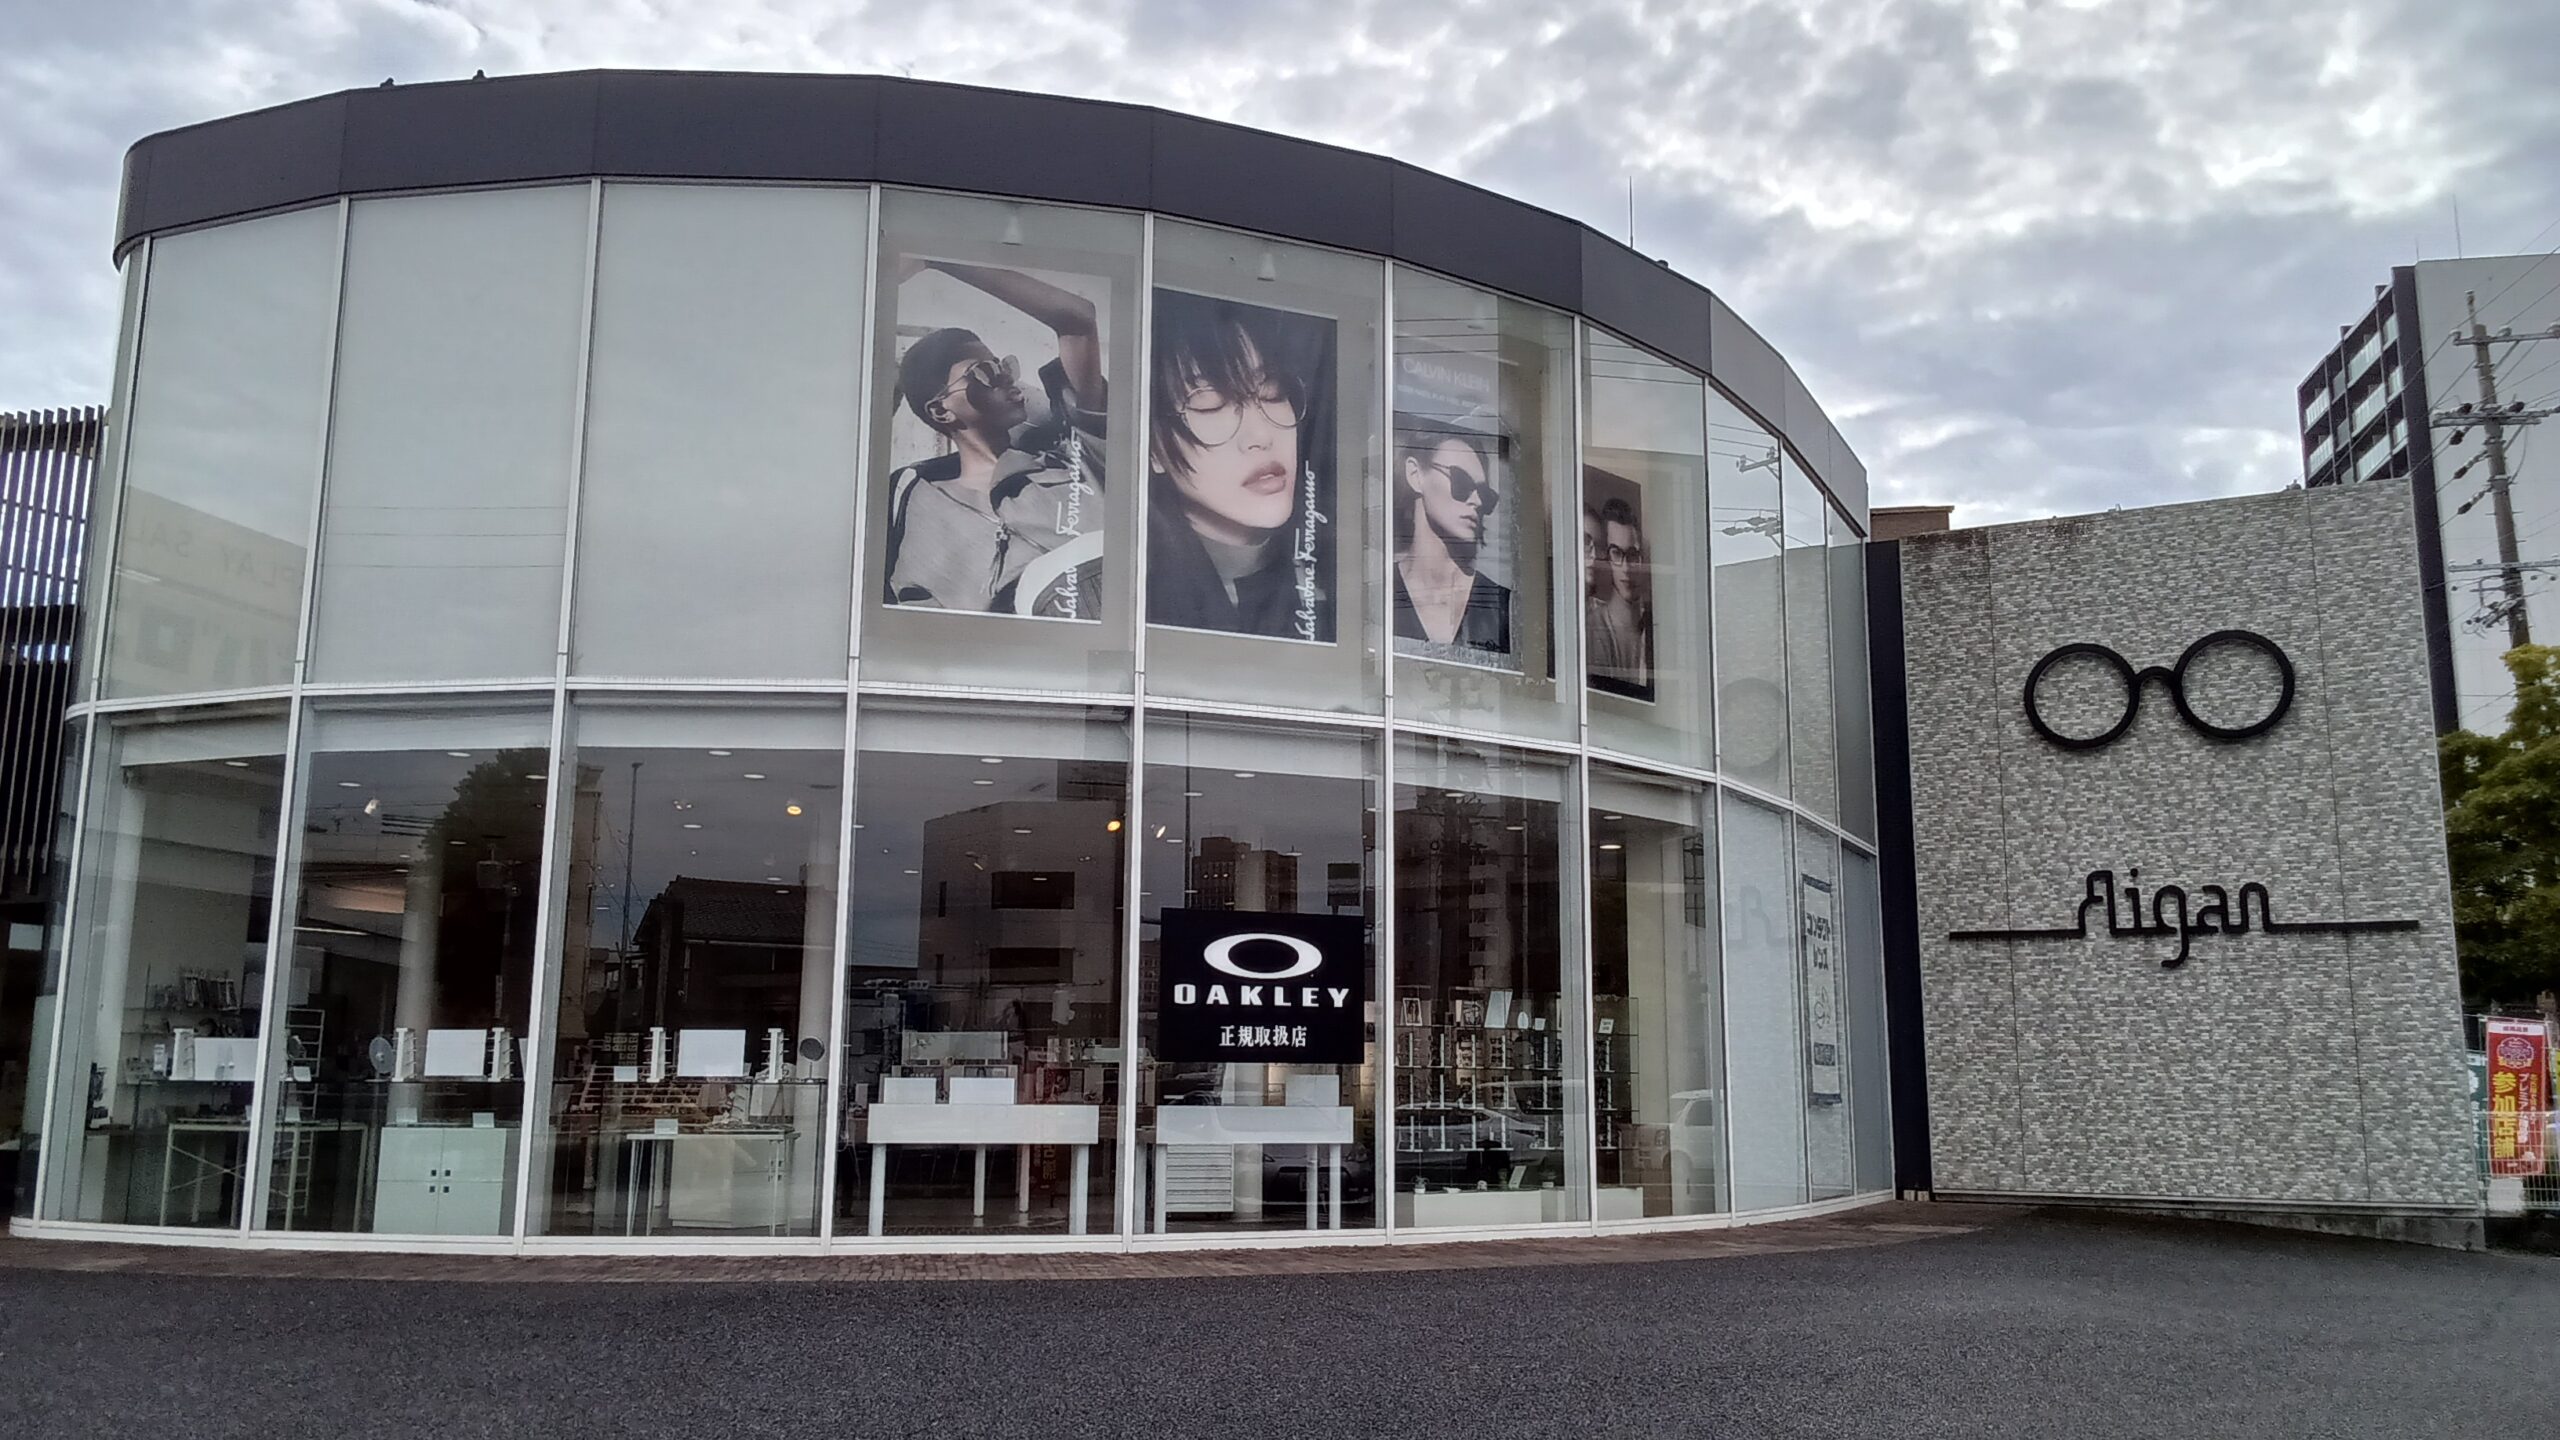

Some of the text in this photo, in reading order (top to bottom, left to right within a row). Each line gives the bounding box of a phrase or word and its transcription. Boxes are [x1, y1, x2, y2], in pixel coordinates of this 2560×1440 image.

[1402, 358, 1451, 384] CALVIN
[1056, 425, 1095, 537] Ferragamo
[1294, 459, 1328, 642] Salvatore Ferragamo
[2077, 867, 2272, 968] Aigan
[1173, 983, 1350, 1008] OAKLEY
[1218, 1024, 1308, 1048] 正規取扱店
[2492, 1071, 2517, 1158] 参加店舗
